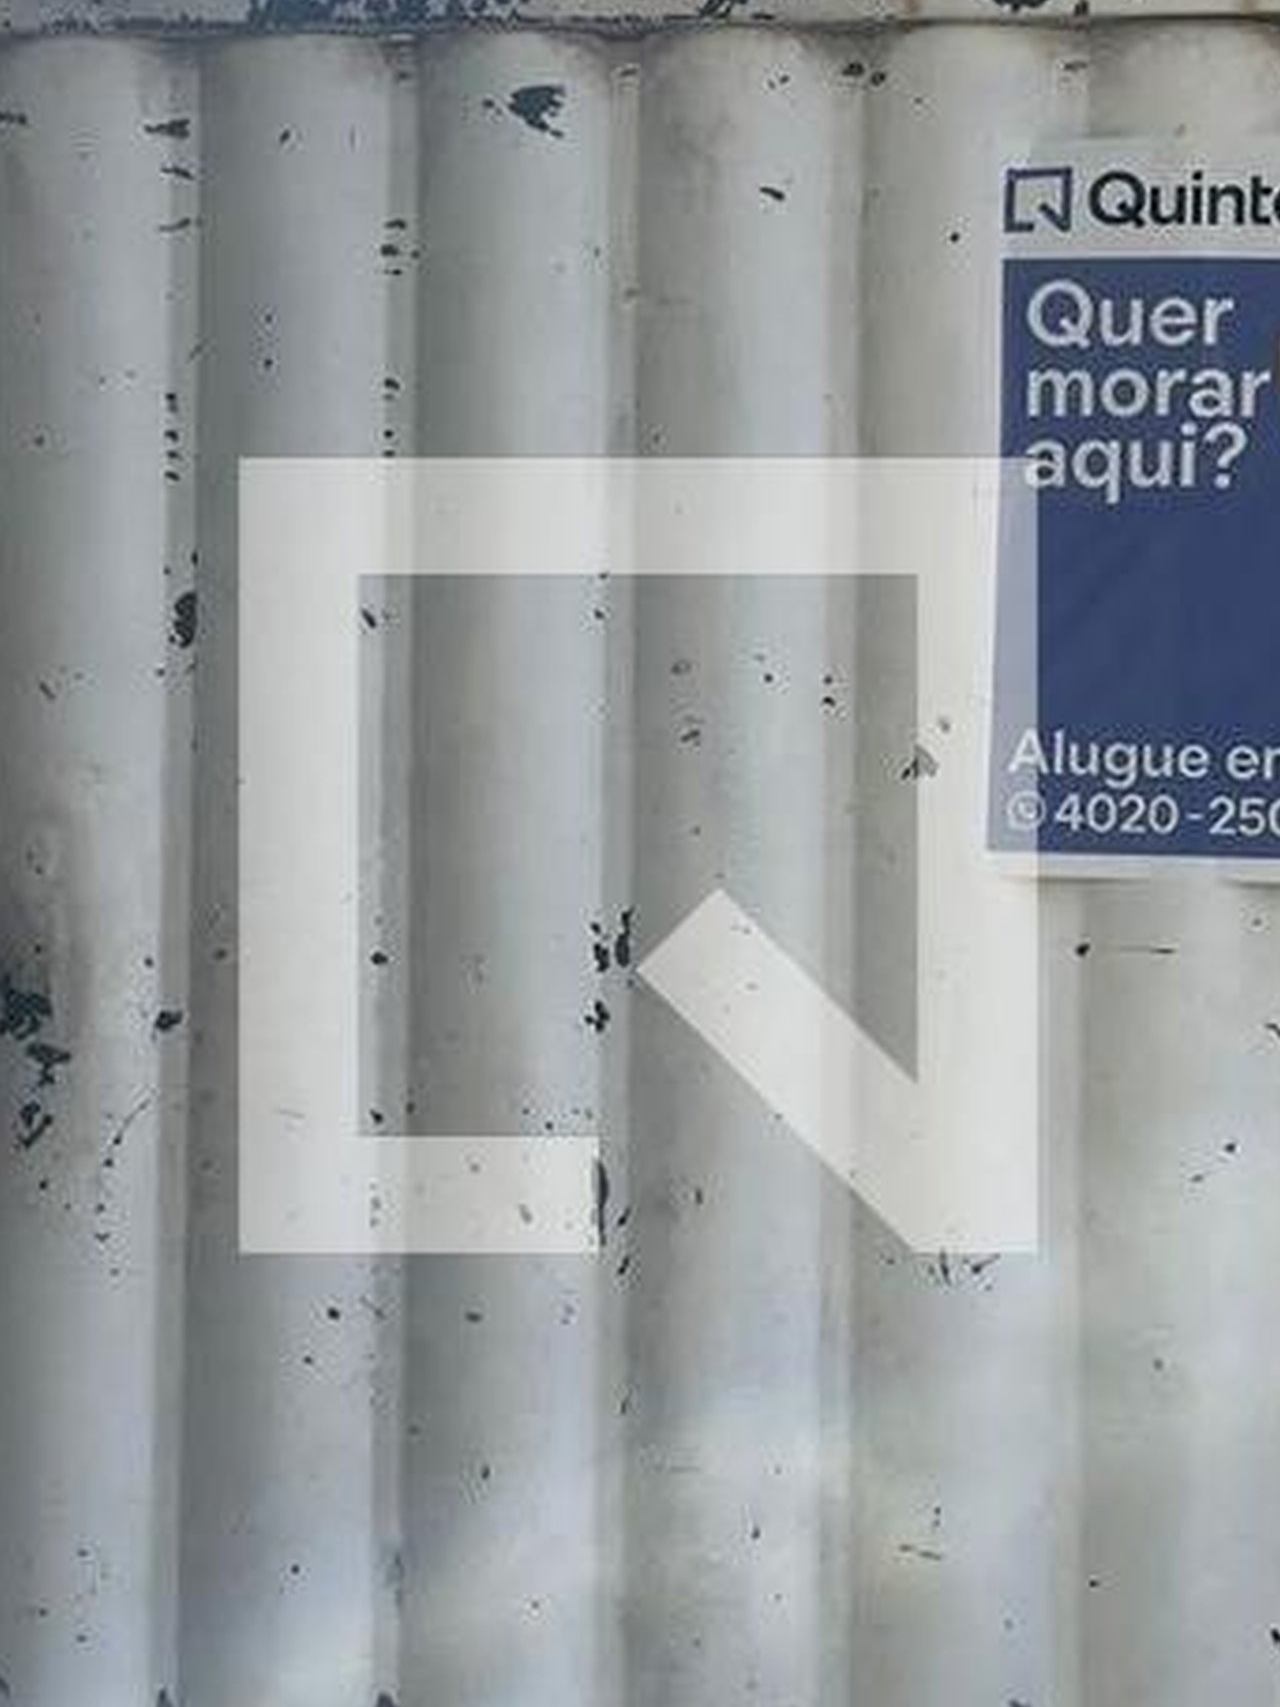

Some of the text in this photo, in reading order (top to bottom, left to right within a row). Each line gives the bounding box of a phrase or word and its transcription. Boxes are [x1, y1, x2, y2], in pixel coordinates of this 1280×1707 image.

[1026, 279, 1234, 348] Quer
[1026, 366, 1271, 418] morar
[1022, 423, 1248, 505] aqui?
[1007, 727, 1210, 789] Alugue
